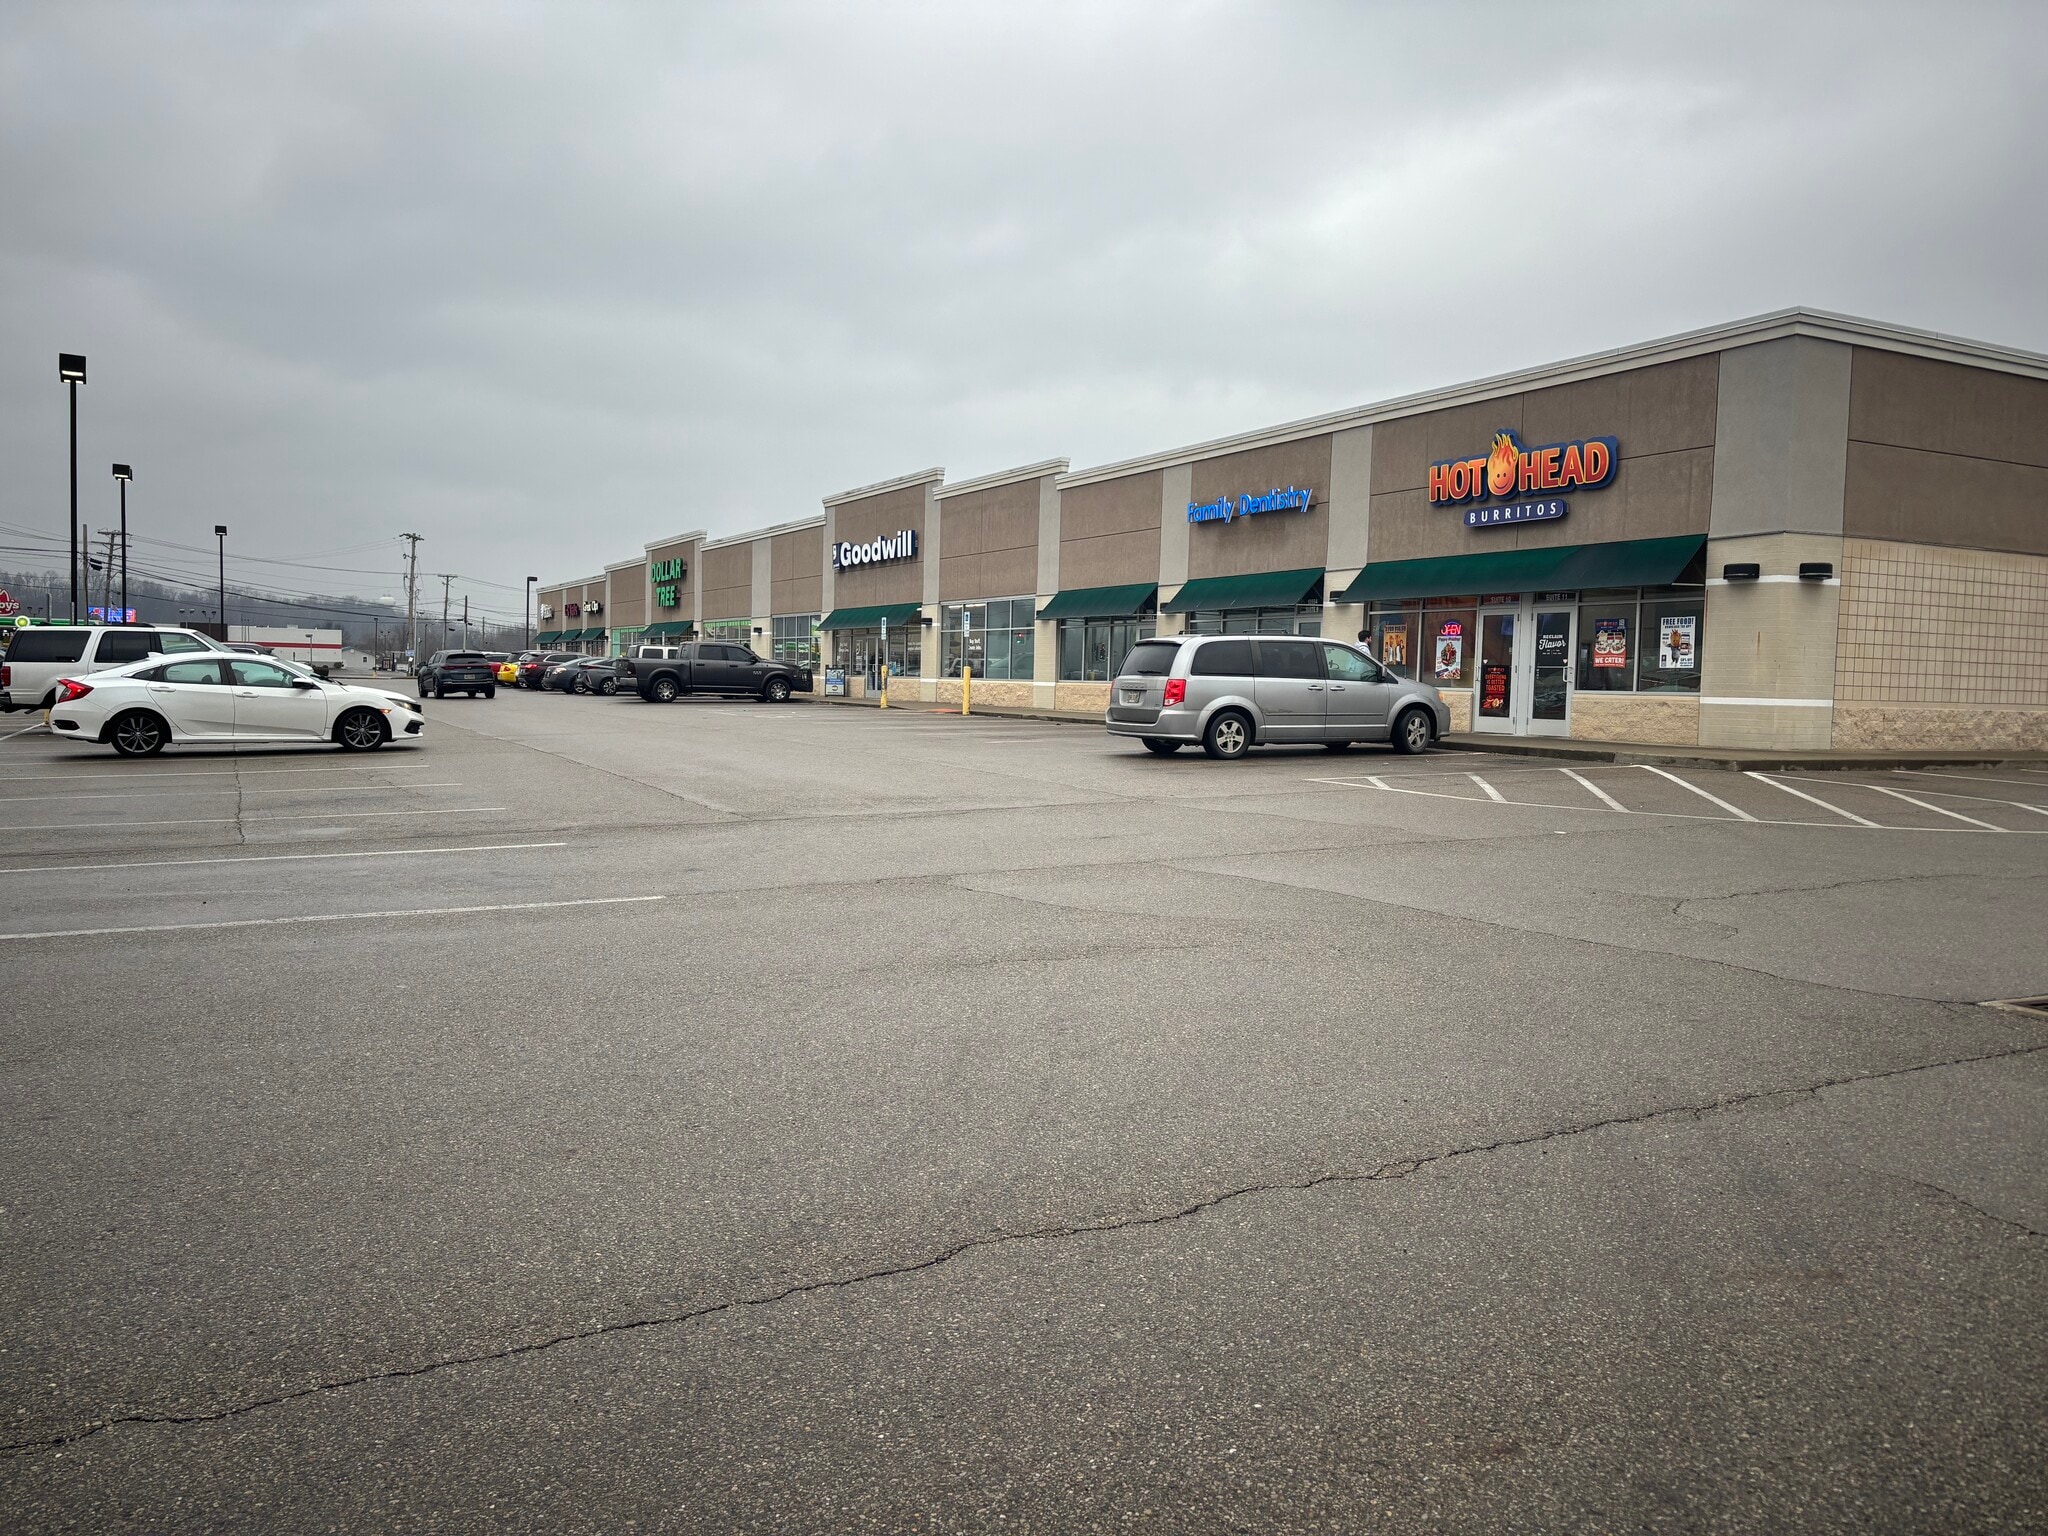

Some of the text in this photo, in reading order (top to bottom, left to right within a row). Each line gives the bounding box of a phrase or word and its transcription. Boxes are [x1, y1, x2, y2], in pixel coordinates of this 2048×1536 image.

[1428, 441, 1610, 503] HOT HEAD
[1187, 485, 1313, 524] Family Dentistry
[1469, 502, 1557, 524] BURRITOS
[840, 529, 915, 567] Goodwill
[651, 557, 683, 584] DOLLAR
[655, 585, 677, 608] TREE
[1662, 617, 1694, 626] FREE FOOD!
[1538, 639, 1567, 650] Flavor
[1594, 657, 1604, 665] WE
